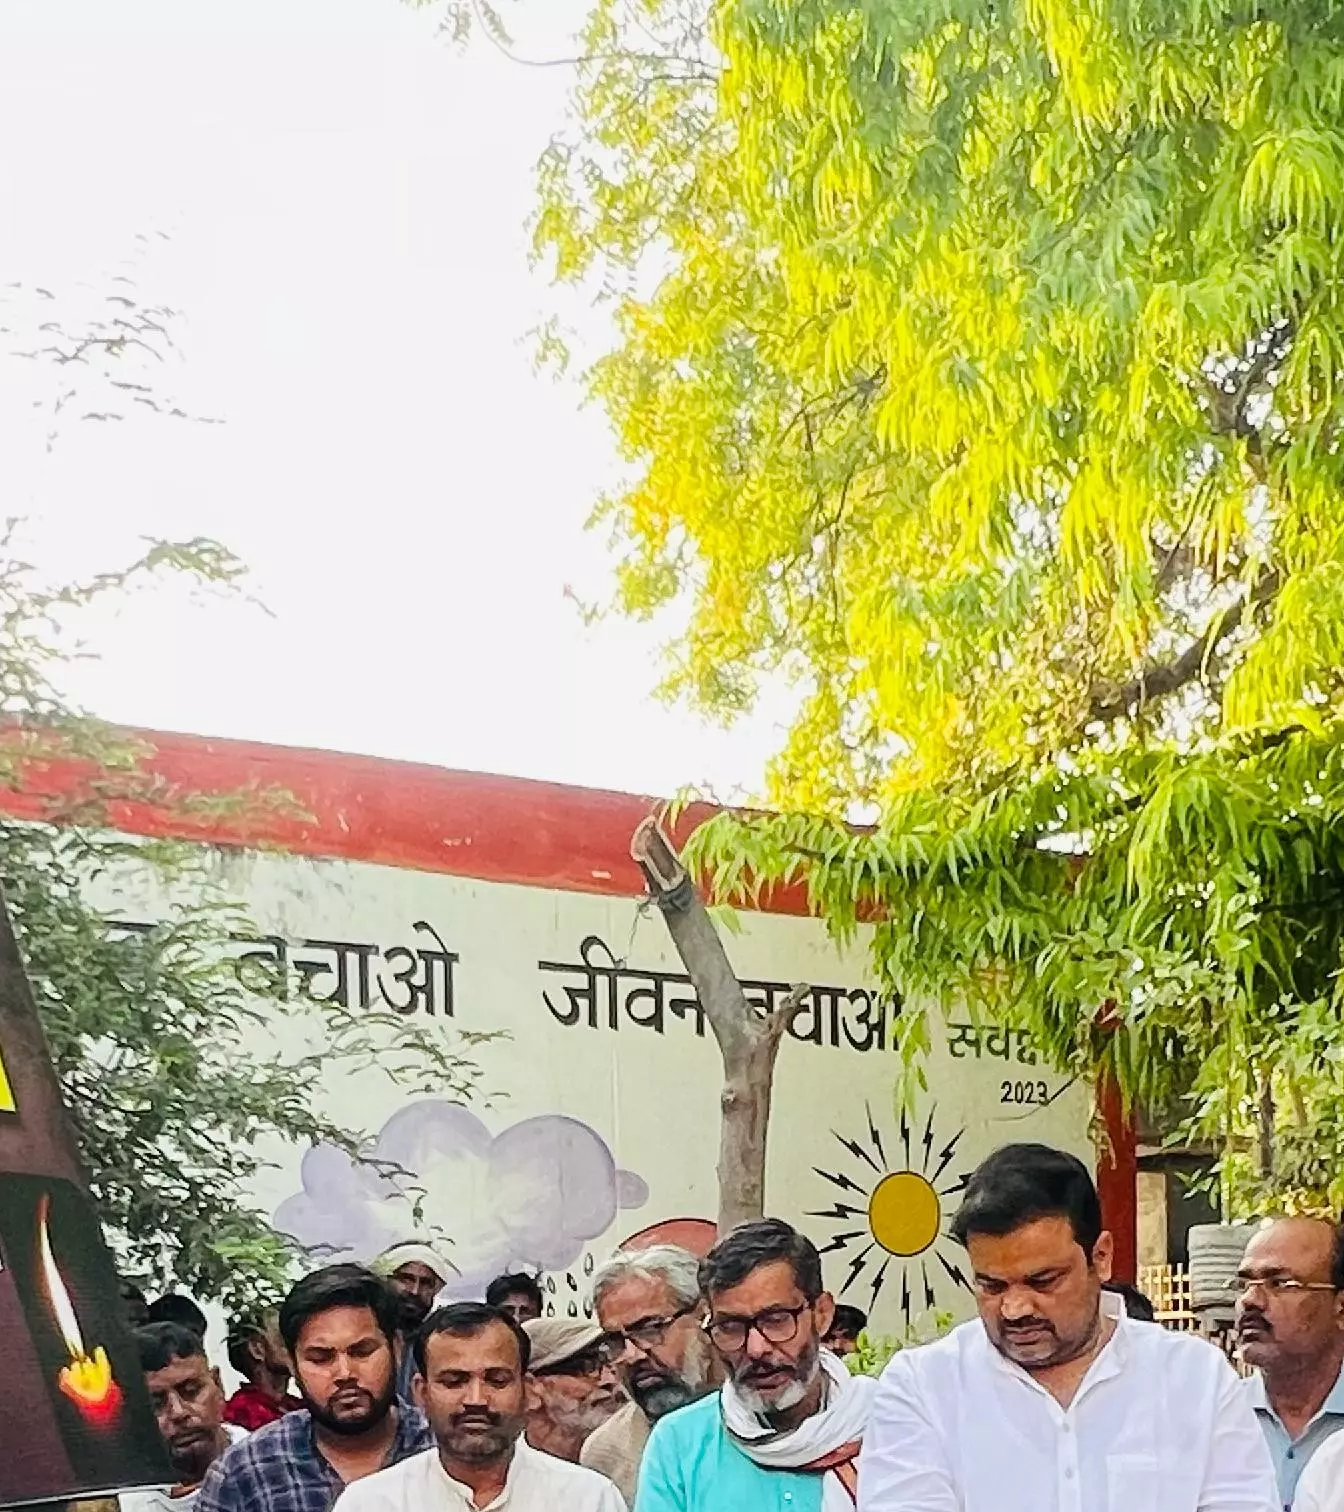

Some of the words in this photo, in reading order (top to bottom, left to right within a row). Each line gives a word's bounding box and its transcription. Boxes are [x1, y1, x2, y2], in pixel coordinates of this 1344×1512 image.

[228, 920, 459, 1017] बचाओ
[538, 934, 706, 1037] जीवन
[1000, 1080, 1050, 1107] 2023
